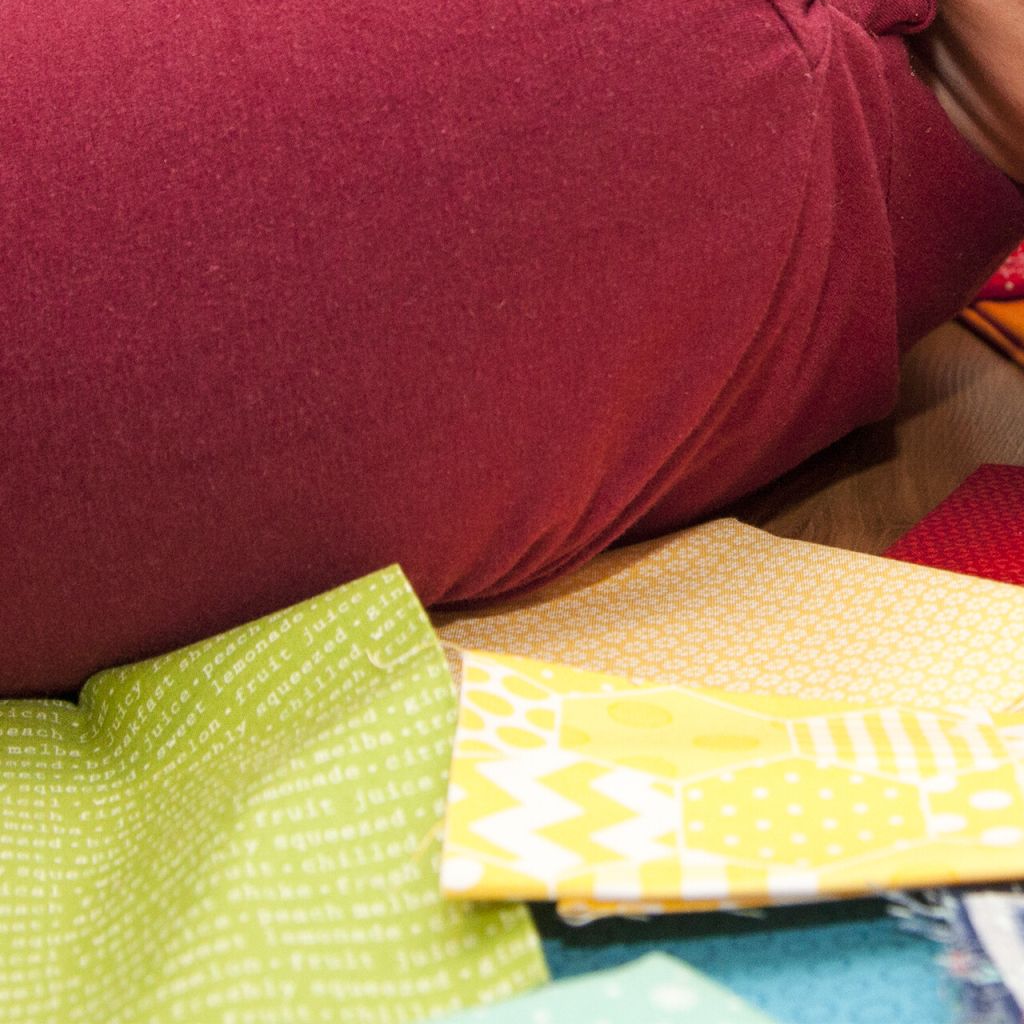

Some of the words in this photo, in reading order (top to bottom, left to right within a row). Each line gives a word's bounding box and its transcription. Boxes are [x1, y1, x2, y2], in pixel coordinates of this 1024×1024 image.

[235, 647, 291, 705] fruit
[303, 592, 361, 646] juice
[143, 689, 190, 753] juice
[202, 625, 261, 680] peach
[156, 700, 206, 760] sweet
[211, 612, 304, 696] lemonade
[255, 627, 347, 717] squeezed
[278, 643, 361, 722] chilled
[7, 745, 81, 759] melba
[313, 732, 395, 768] melba
[255, 797, 336, 828] fruit
[355, 776, 433, 816] juice
[273, 808, 407, 853] squeezed
[301, 833, 418, 872] chilled
[351, 890, 438, 919] melba
[290, 950, 373, 971] fruit
[311, 970, 450, 1002] squeezed
